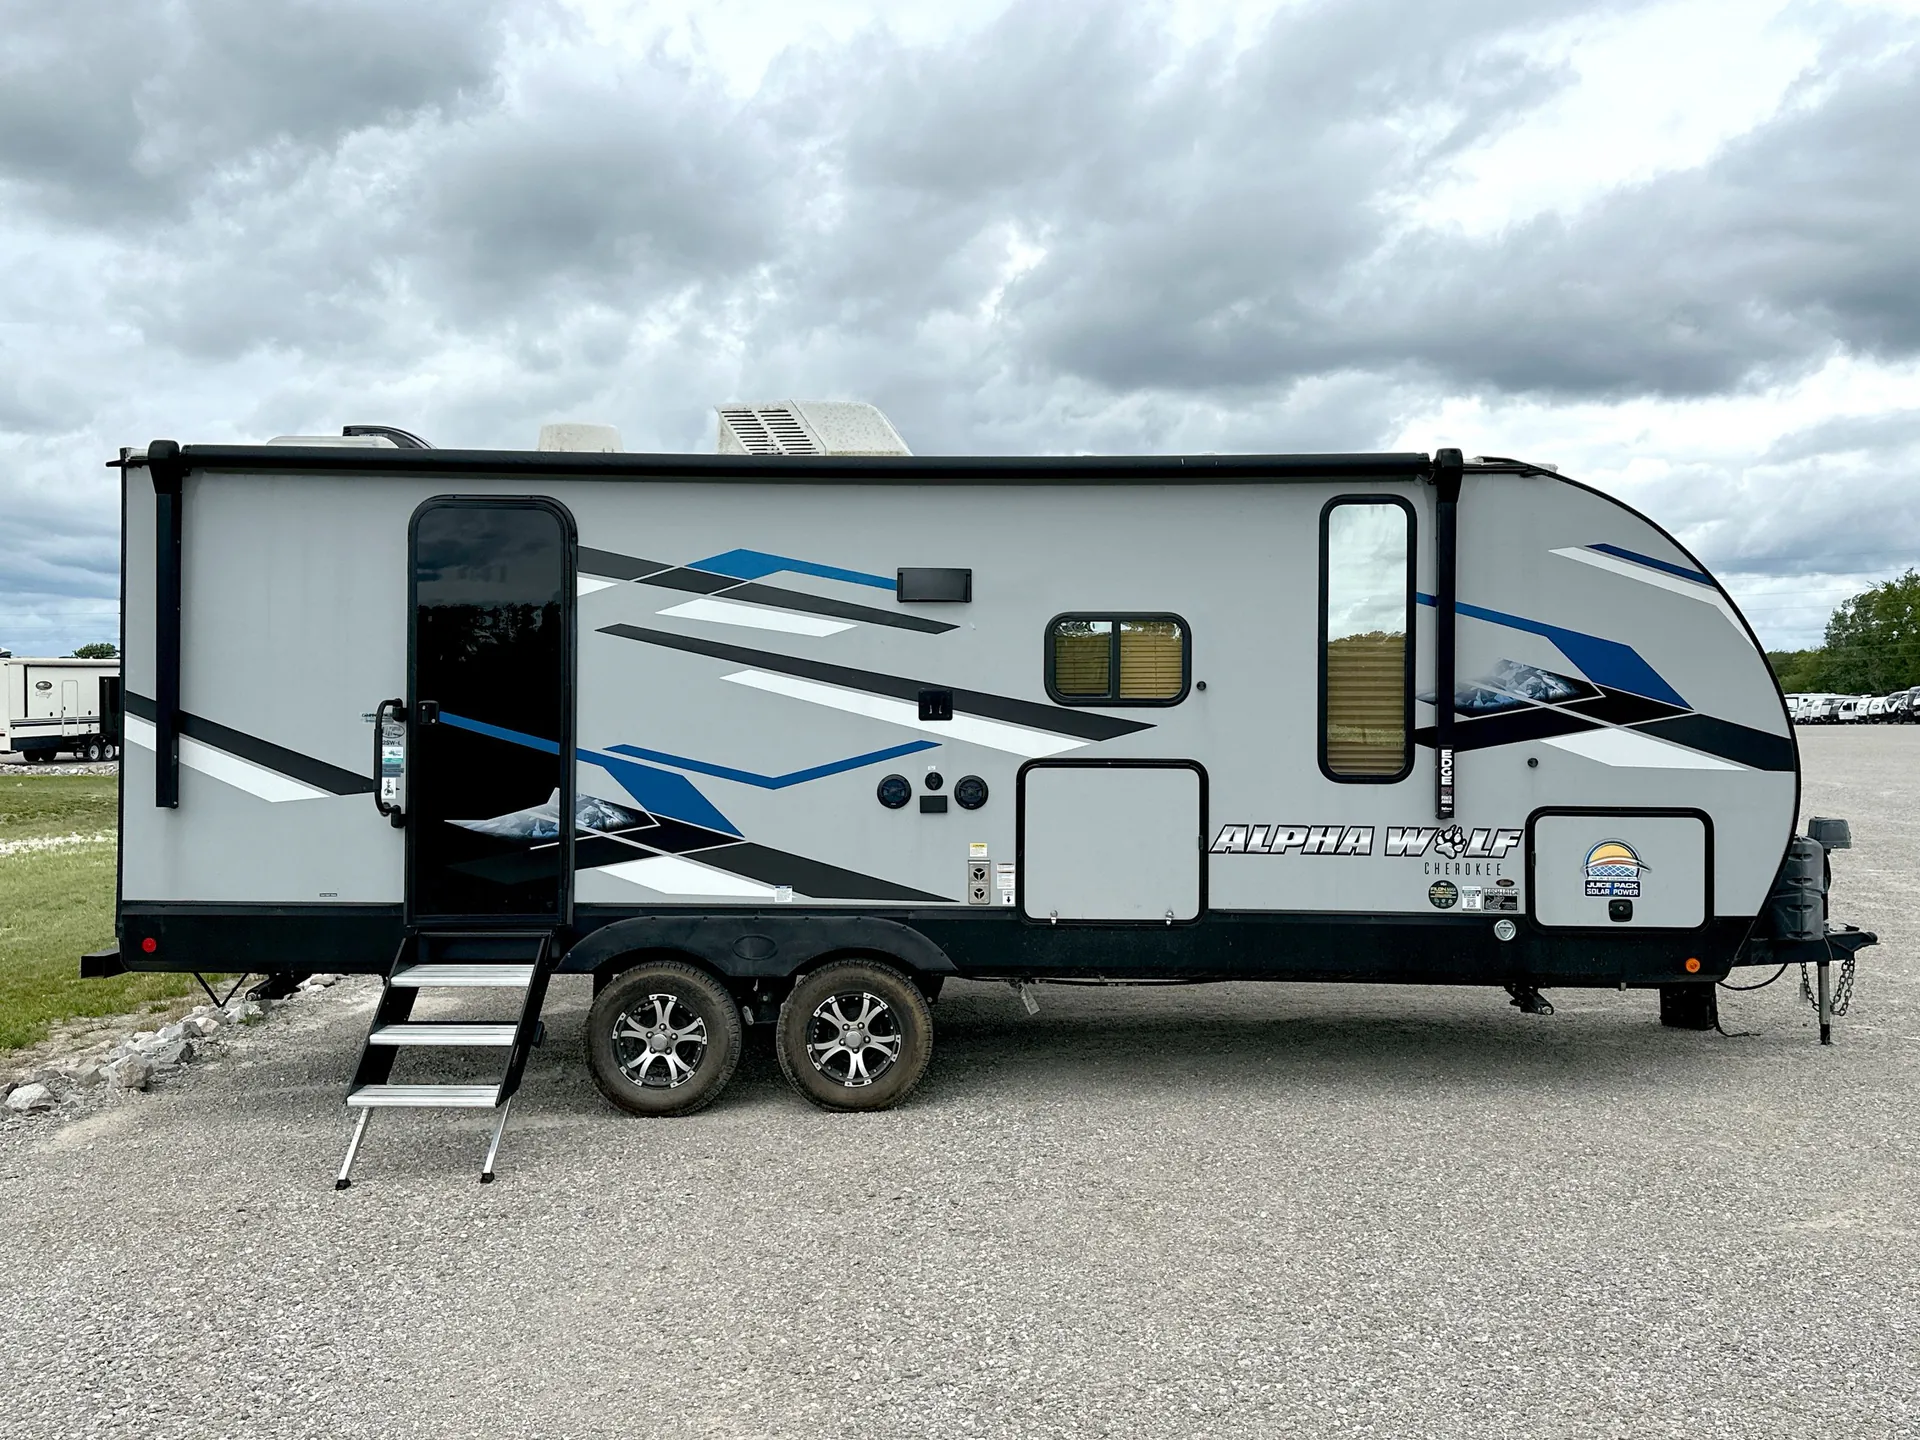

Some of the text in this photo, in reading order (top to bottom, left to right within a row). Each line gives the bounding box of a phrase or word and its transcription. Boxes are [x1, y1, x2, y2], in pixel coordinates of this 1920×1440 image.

[1441, 749, 1453, 786] EDGE
[1208, 824, 1375, 856] ALPHA
[1424, 861, 1502, 876] CHEROKEE
